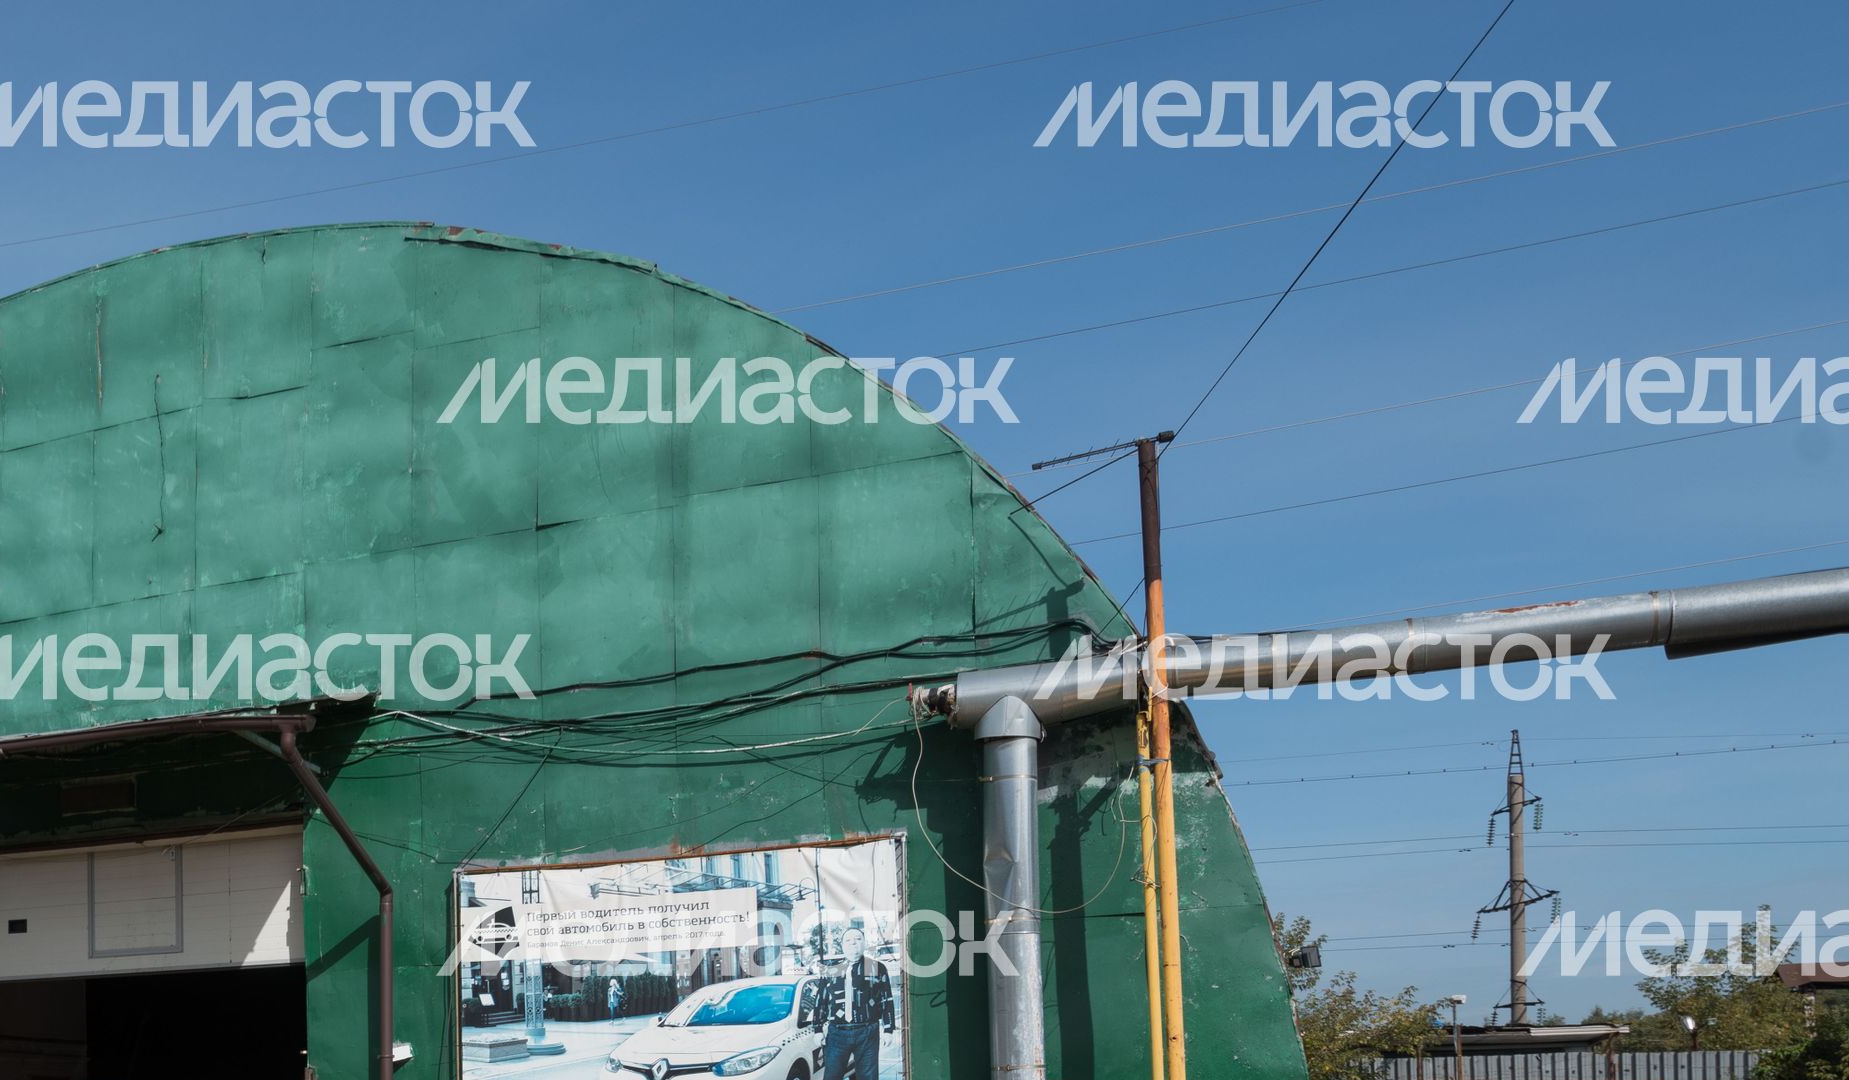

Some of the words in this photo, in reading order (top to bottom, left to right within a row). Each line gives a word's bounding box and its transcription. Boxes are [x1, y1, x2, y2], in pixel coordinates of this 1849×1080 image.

[527, 911, 576, 923] Первый
[581, 906, 644, 919] водитель
[648, 901, 710, 914] получил
[527, 926, 554, 936] свой
[559, 921, 634, 935] автомобиль
[638, 921, 646, 930] в
[649, 911, 750, 929] собственность!
